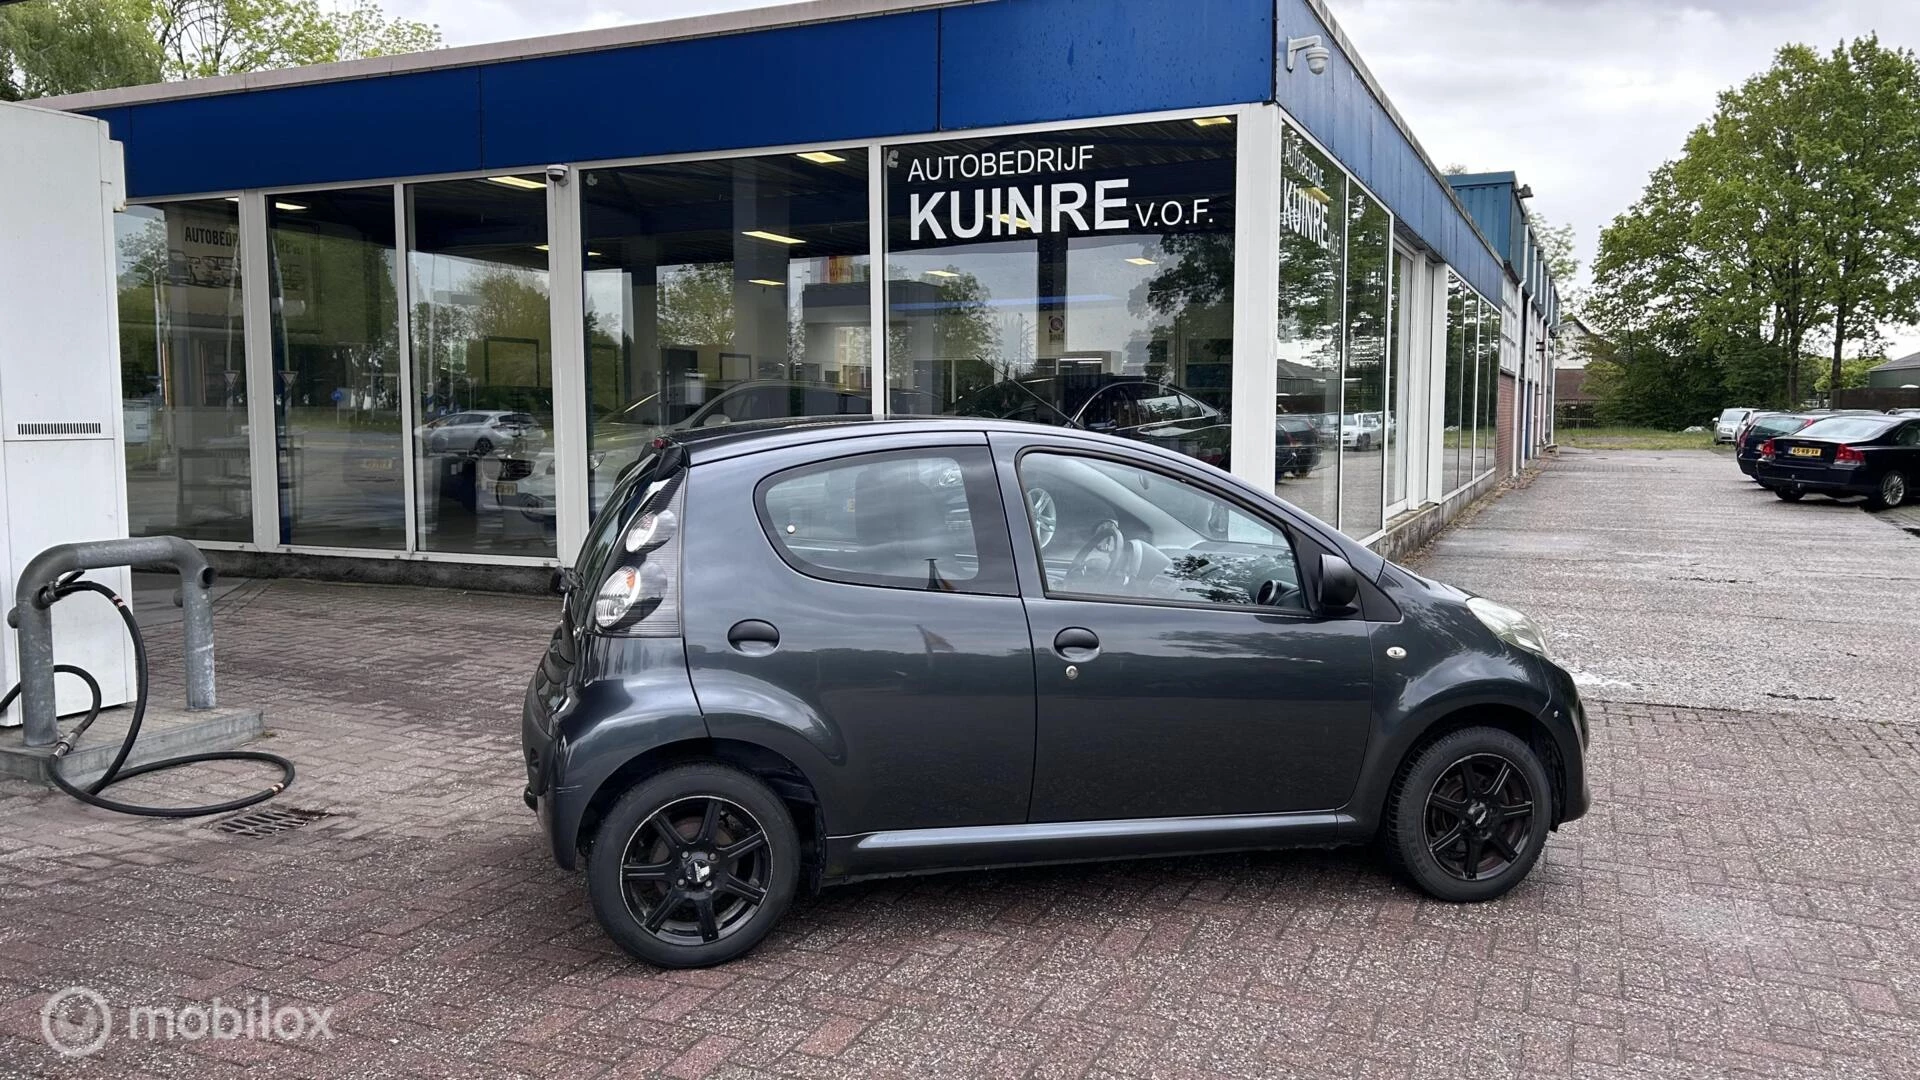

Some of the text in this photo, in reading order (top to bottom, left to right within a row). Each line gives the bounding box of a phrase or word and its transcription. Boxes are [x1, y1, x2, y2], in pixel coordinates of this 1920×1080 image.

[908, 145, 1094, 182] AUTOBEDRIJF
[910, 179, 1214, 240] KUINRE V.O.F.
[1283, 177, 1329, 250] KUINRE
[185, 226, 240, 247] AUTOBEDR
